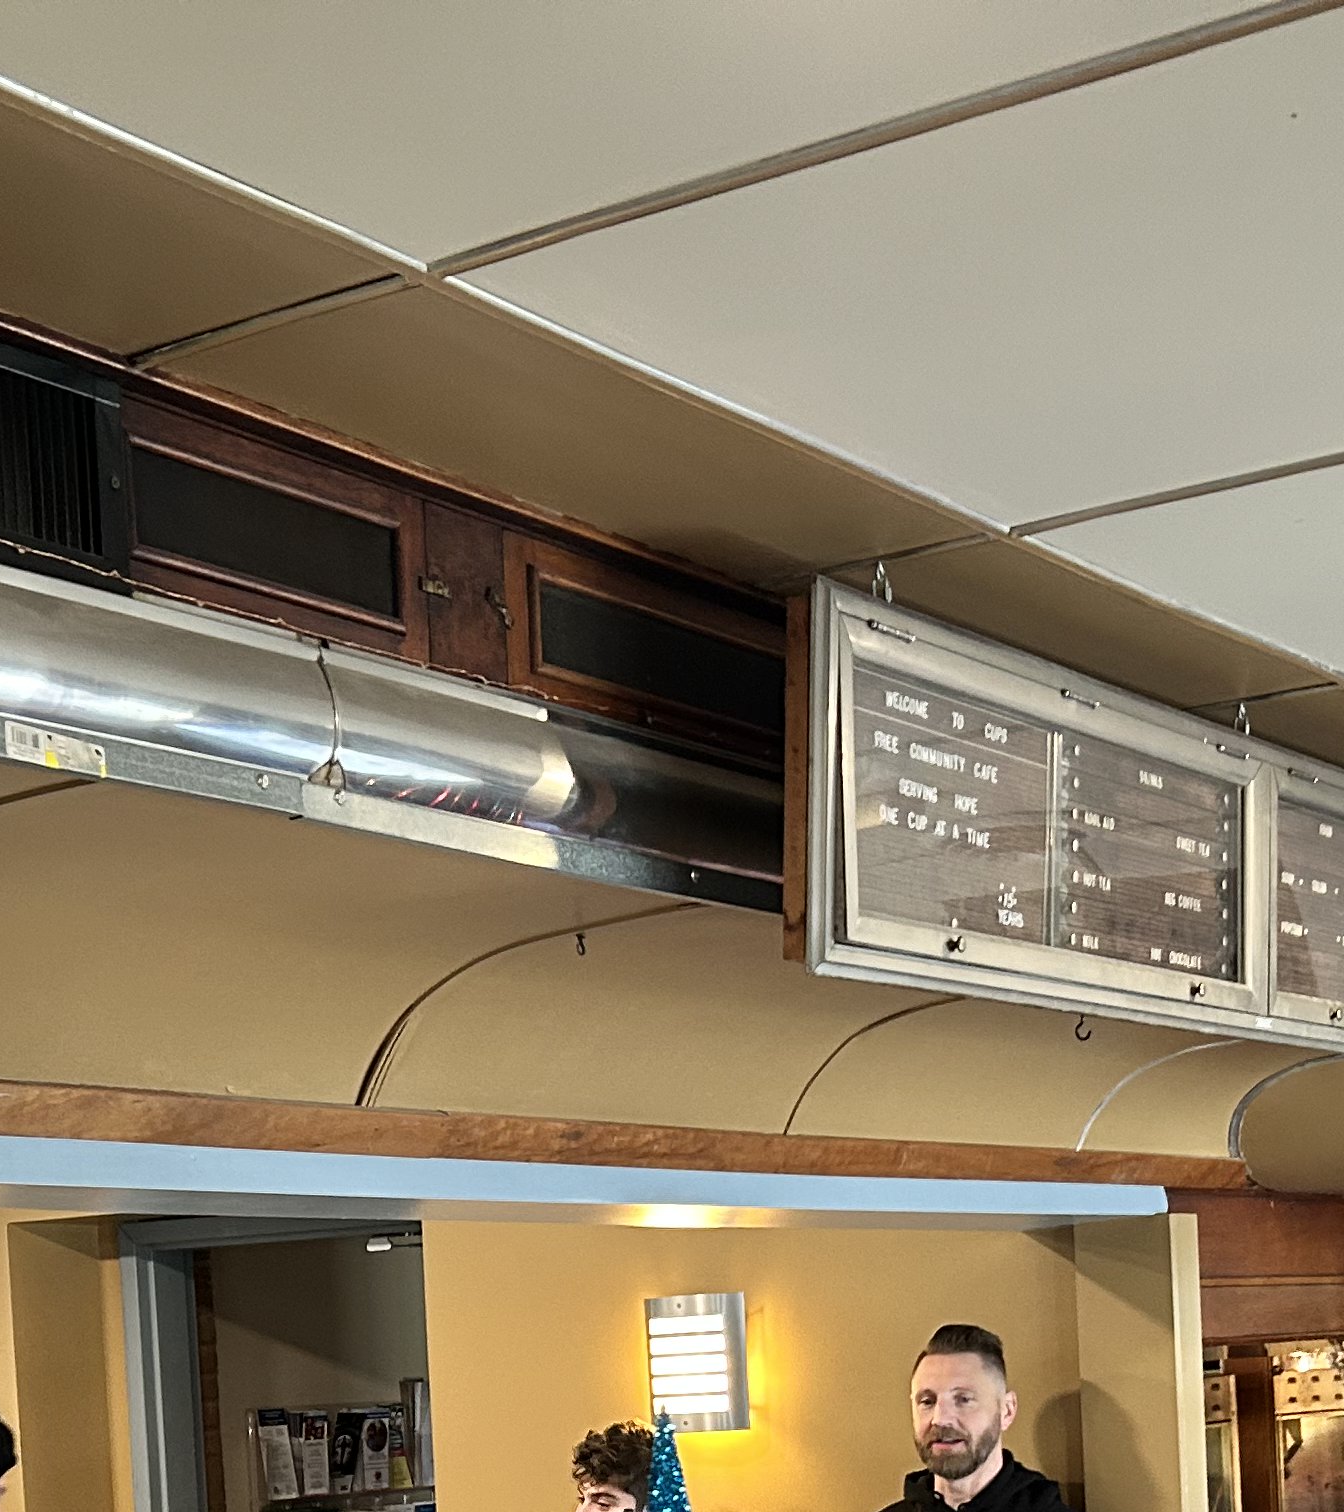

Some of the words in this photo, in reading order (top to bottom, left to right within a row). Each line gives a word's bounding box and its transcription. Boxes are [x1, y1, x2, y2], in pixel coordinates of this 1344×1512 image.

[885, 690, 929, 719] WELCOME
[952, 711, 965, 729] TO
[984, 722, 1008, 744] CUPS
[874, 730, 899, 754] FREE
[909, 742, 965, 772] COMMUNITY
[973, 762, 998, 784] CAFE
[898, 778, 938, 804] SERVING
[954, 793, 978, 815] HOPE
[878, 803, 899, 825] ONE
[907, 811, 928, 831] CUP
[934, 820, 947, 836] AT
[952, 824, 960, 840] A
[966, 827, 991, 849] TIME
